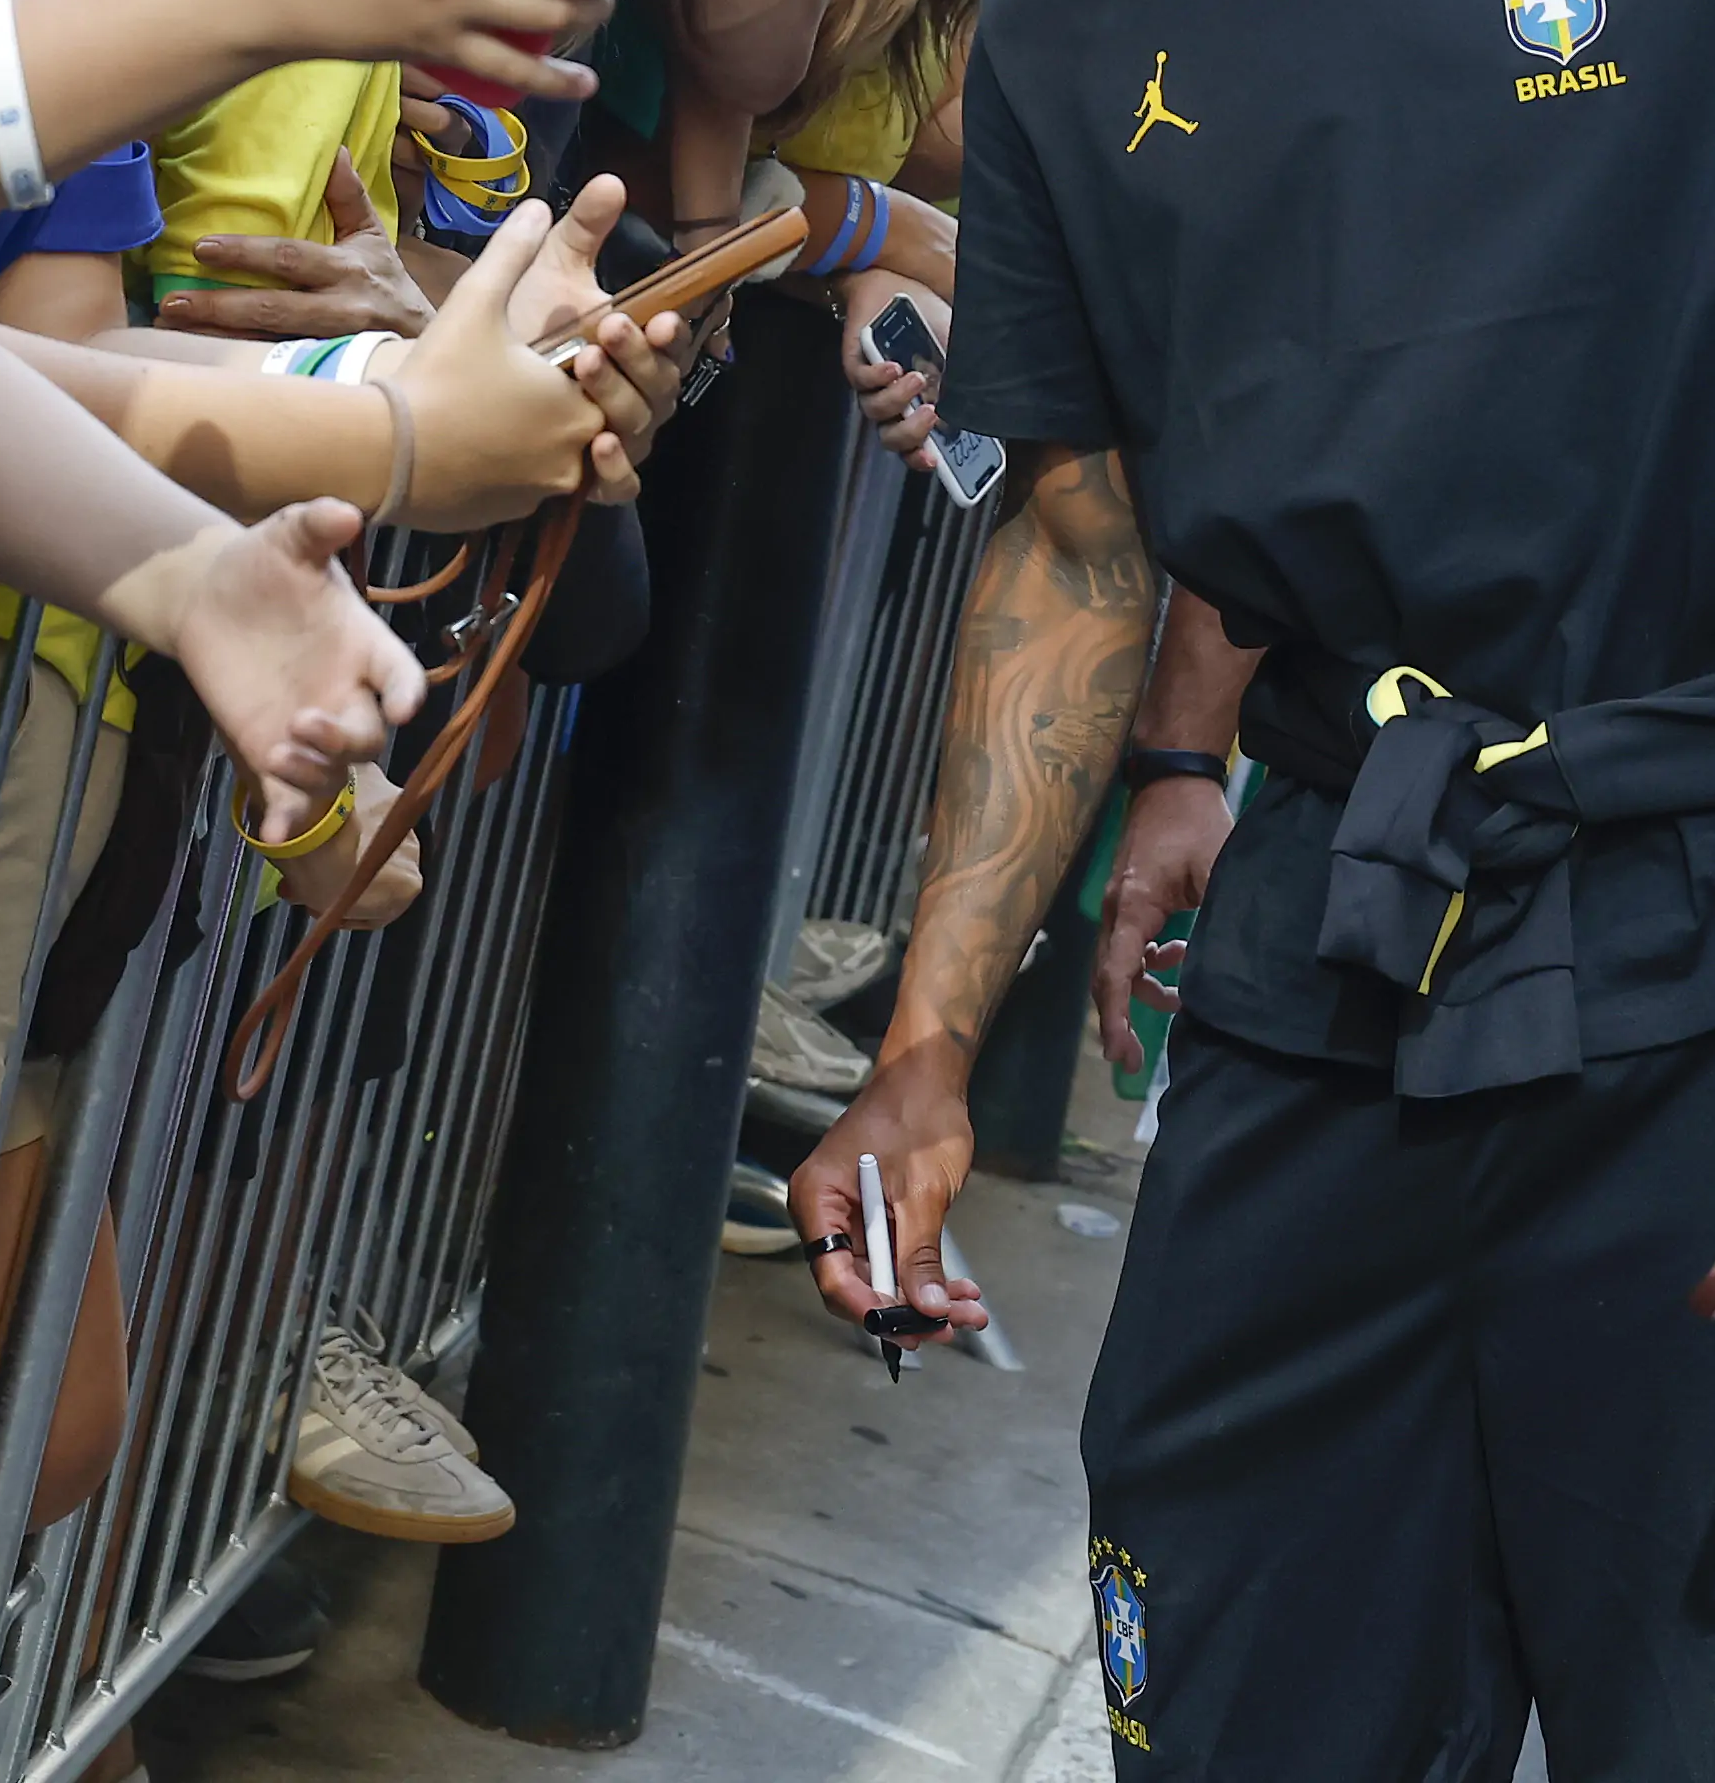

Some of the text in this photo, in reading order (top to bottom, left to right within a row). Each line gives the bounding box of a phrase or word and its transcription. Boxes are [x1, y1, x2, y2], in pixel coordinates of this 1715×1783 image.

[1515, 61, 1627, 103] BRASIL
[1116, 1618, 1135, 1640] CBF
[1107, 1704, 1152, 1752] BRASIL
